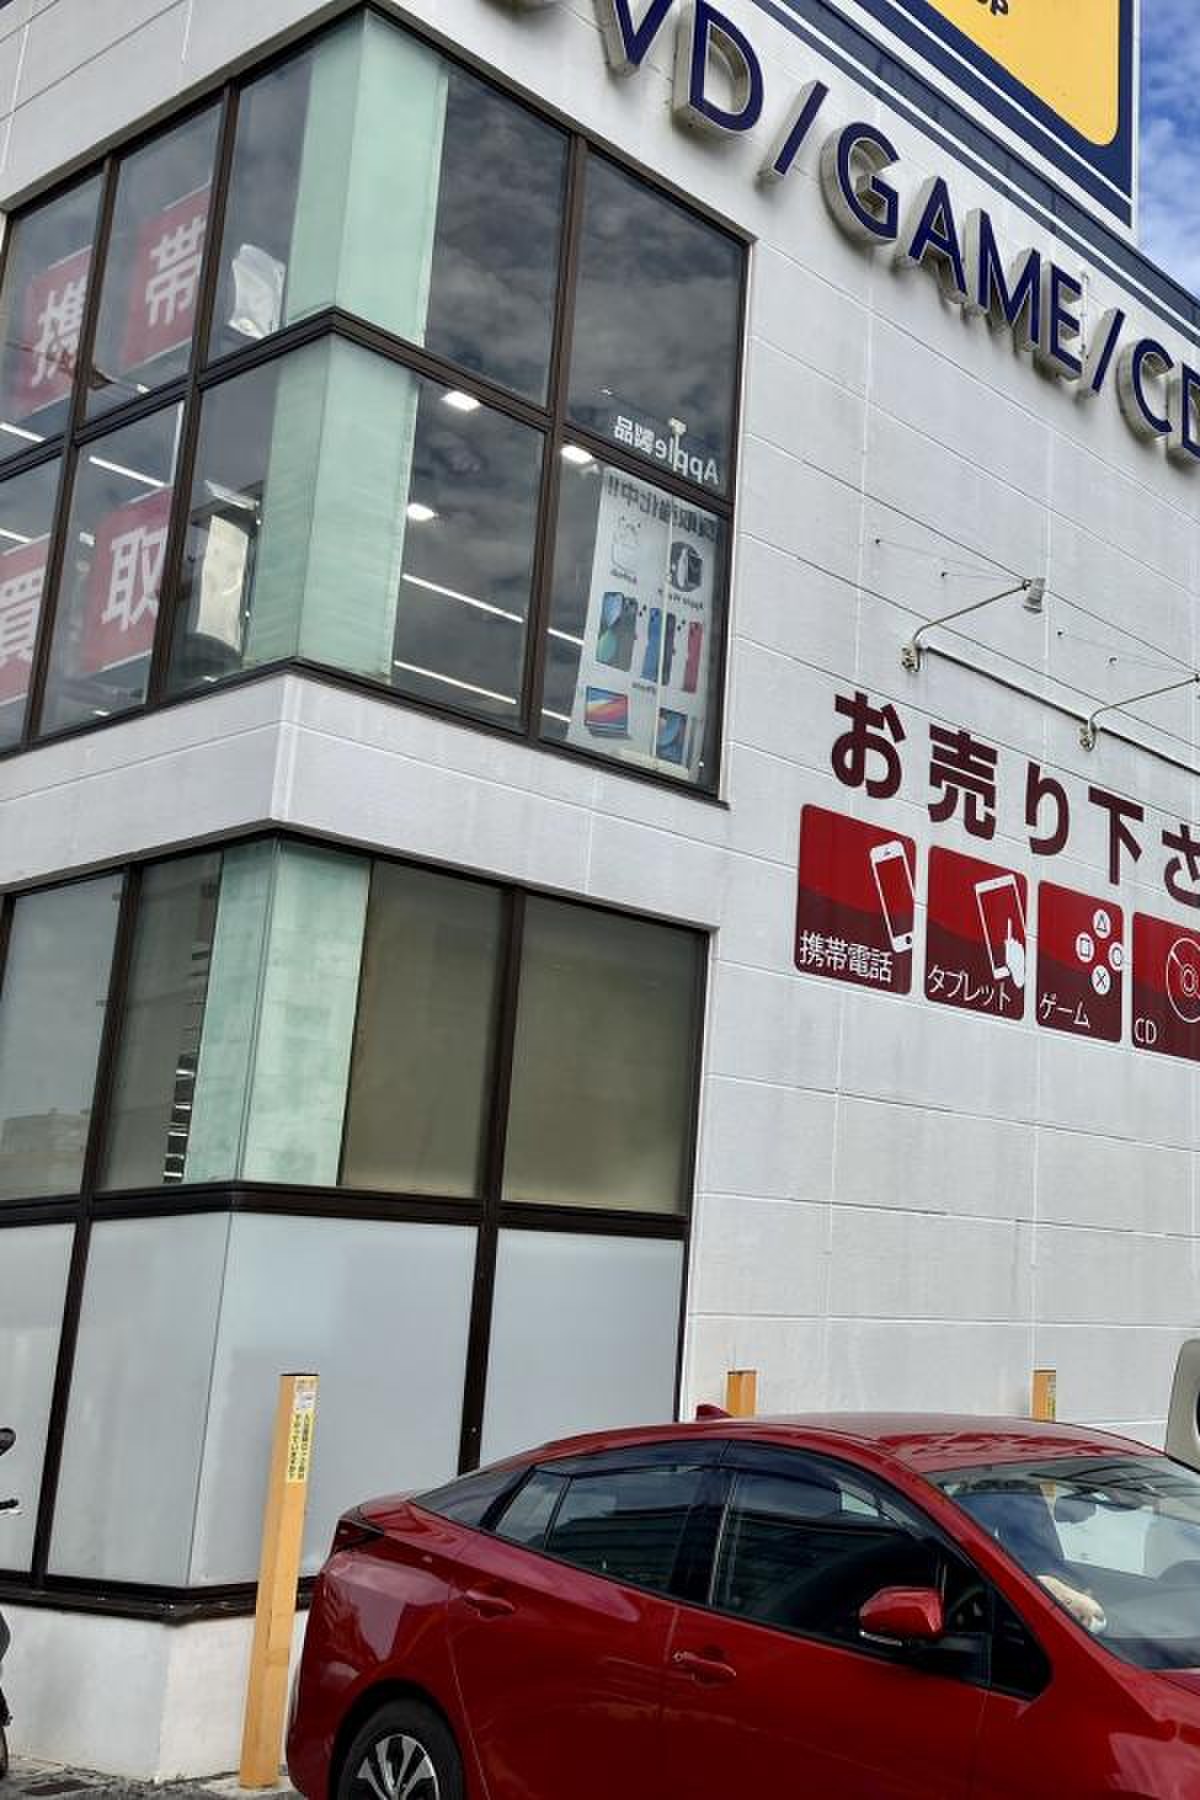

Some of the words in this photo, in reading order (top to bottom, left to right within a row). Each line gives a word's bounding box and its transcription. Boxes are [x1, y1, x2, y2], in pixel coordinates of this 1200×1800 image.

[799, 929, 893, 984] 携帯電話
[928, 963, 1012, 1011] タブレット
[1038, 994, 1092, 1029] ゲーム
[1134, 1018, 1158, 1045] CD
